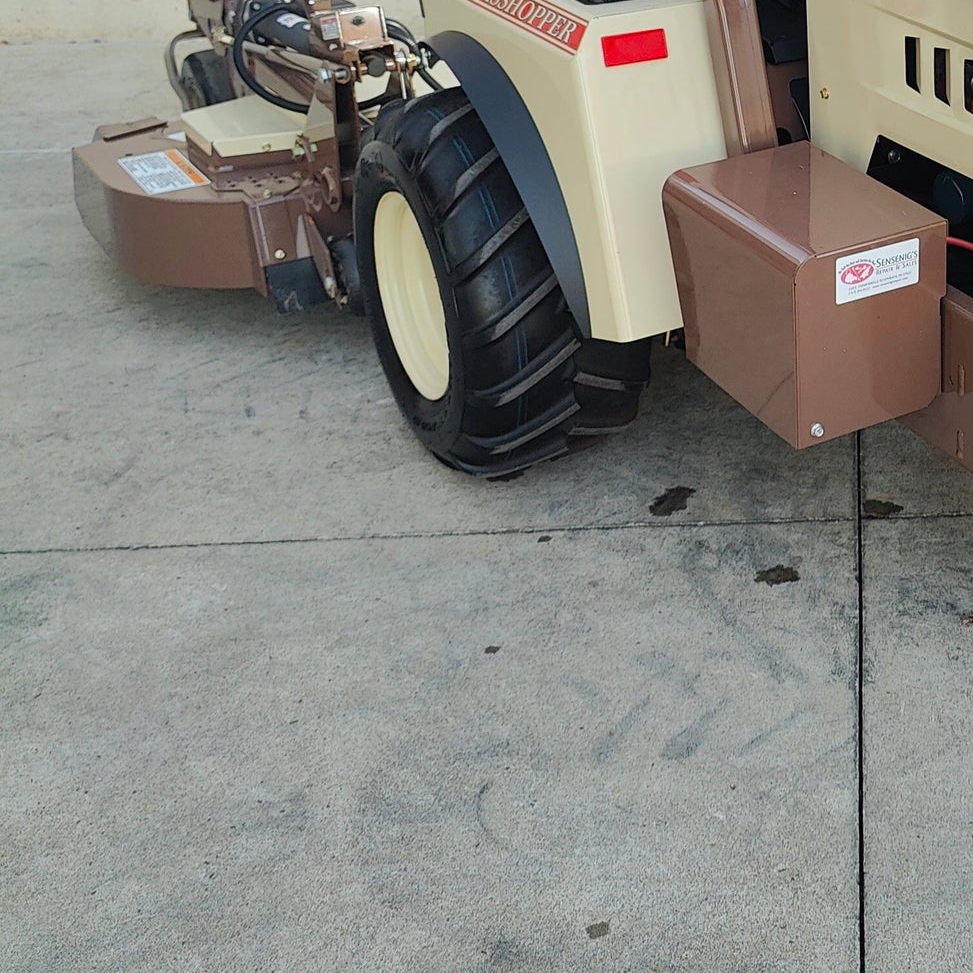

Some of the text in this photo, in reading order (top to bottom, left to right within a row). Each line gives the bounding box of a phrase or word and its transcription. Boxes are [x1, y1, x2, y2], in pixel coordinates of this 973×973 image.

[875, 250, 918, 268] SENSENIG'S
[875, 266, 894, 276] REPAIR
[902, 260, 917, 269] SALES
